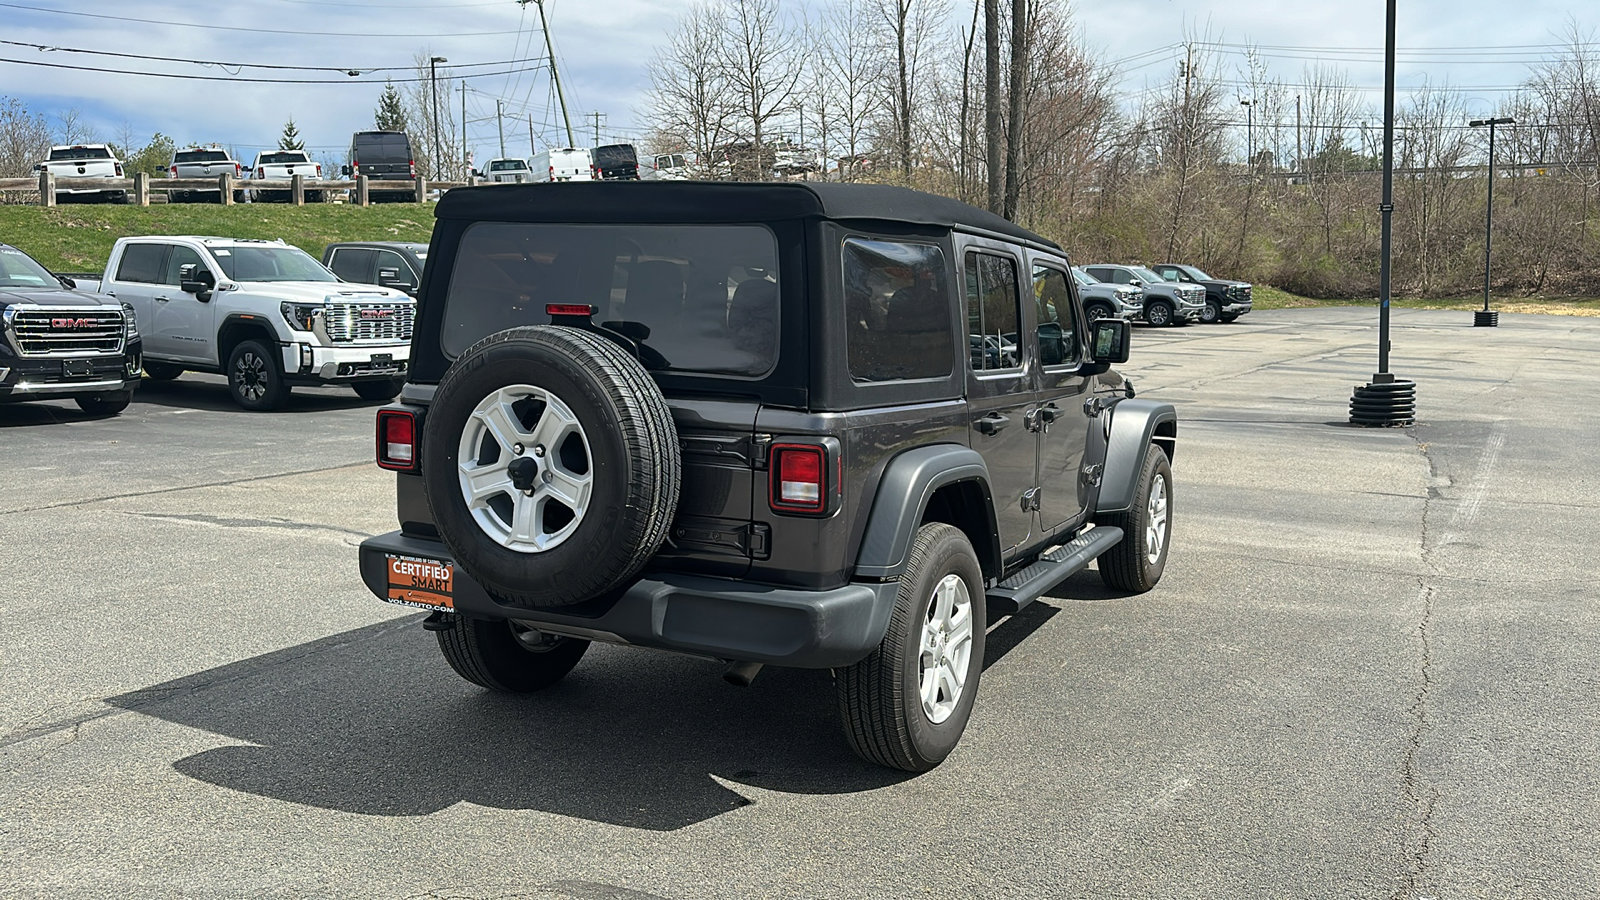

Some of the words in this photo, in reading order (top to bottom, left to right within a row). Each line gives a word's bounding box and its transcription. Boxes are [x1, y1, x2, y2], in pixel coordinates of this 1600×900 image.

[361, 309, 394, 319] GMC
[52, 318, 98, 328] GMC
[393, 561, 450, 580] CERTIFIED
[411, 576, 450, 592] SMART
[386, 598, 455, 613] VOLZAUTO.COM
